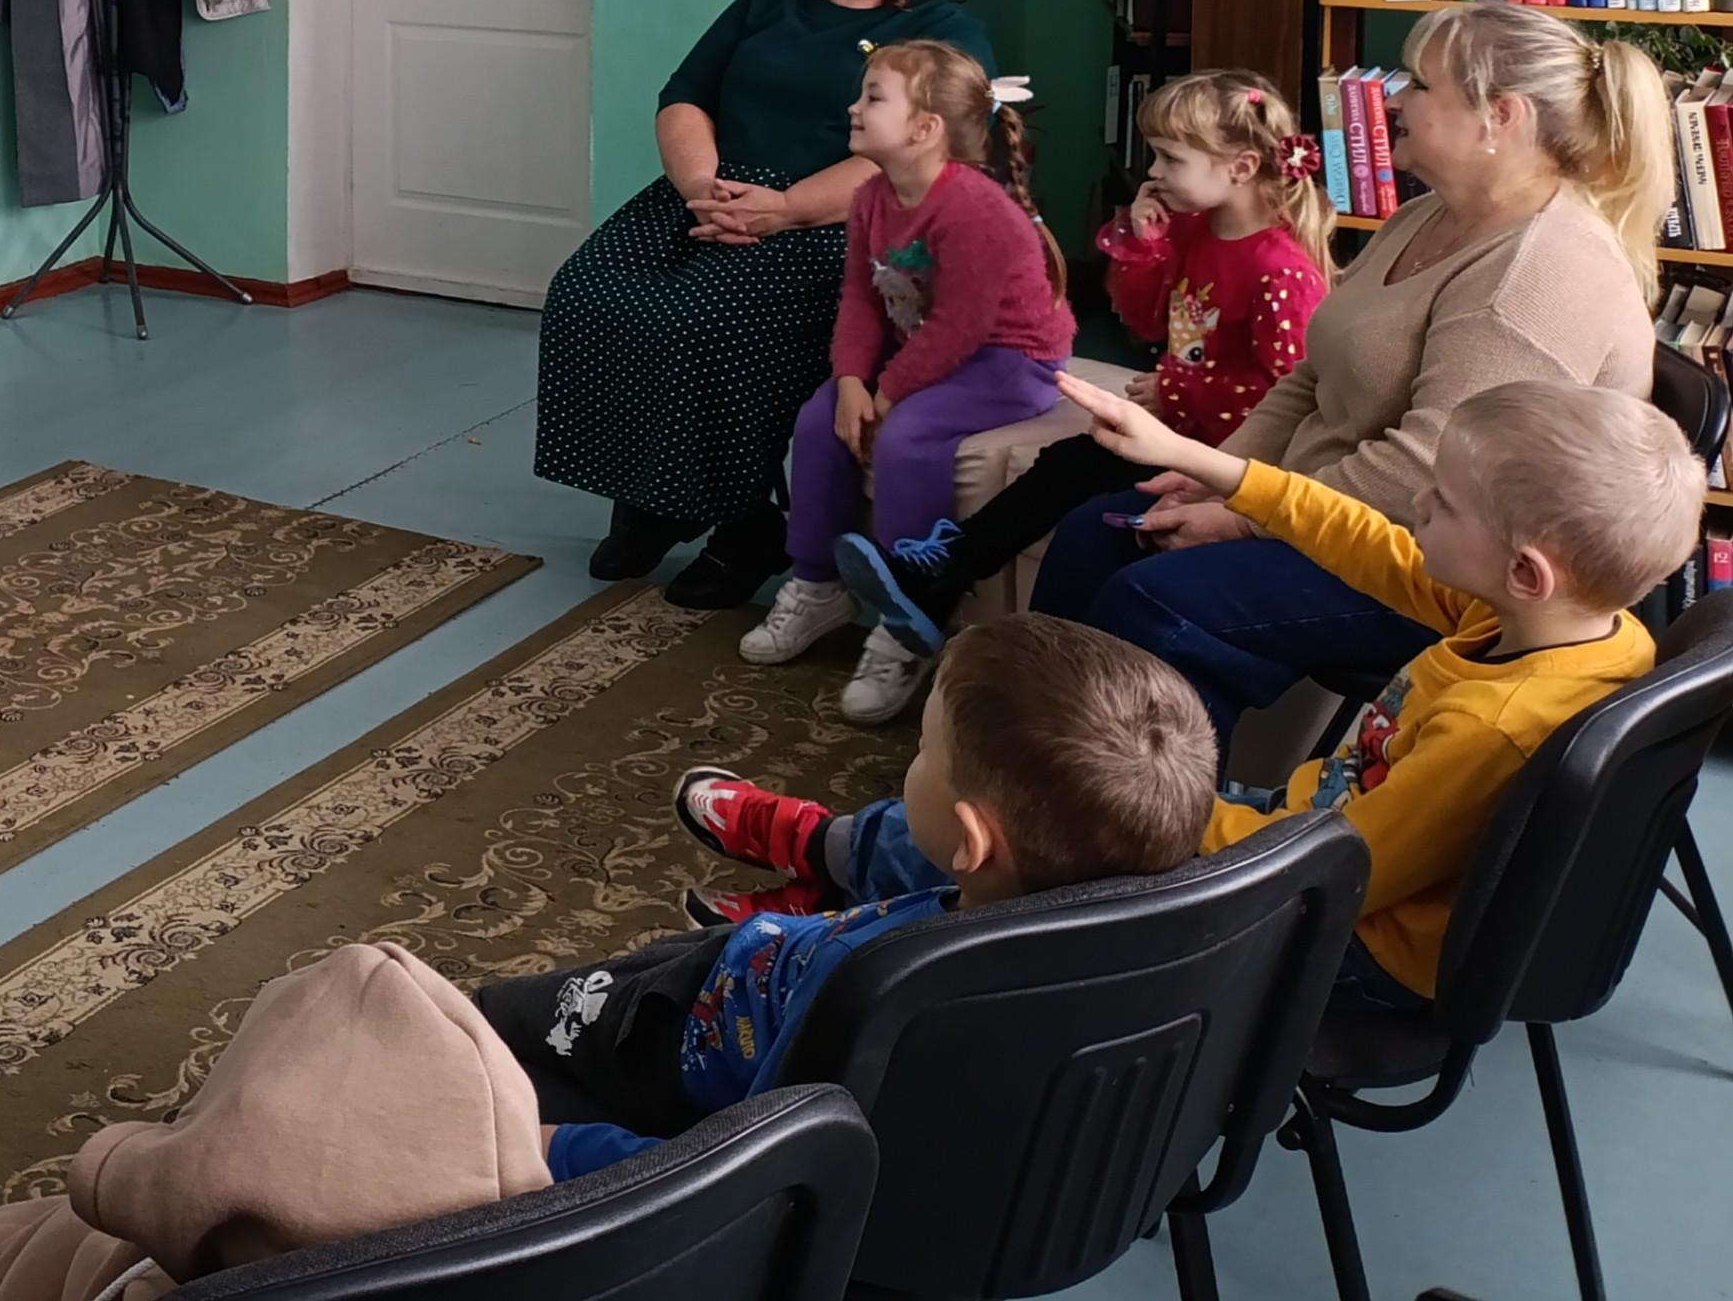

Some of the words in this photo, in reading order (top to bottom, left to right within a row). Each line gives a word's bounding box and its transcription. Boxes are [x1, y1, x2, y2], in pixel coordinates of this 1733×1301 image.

[1349, 122, 1367, 164] СТИЛ
[1372, 125, 1392, 167] СТИЛ
[735, 1015, 756, 1060] NARUTO
